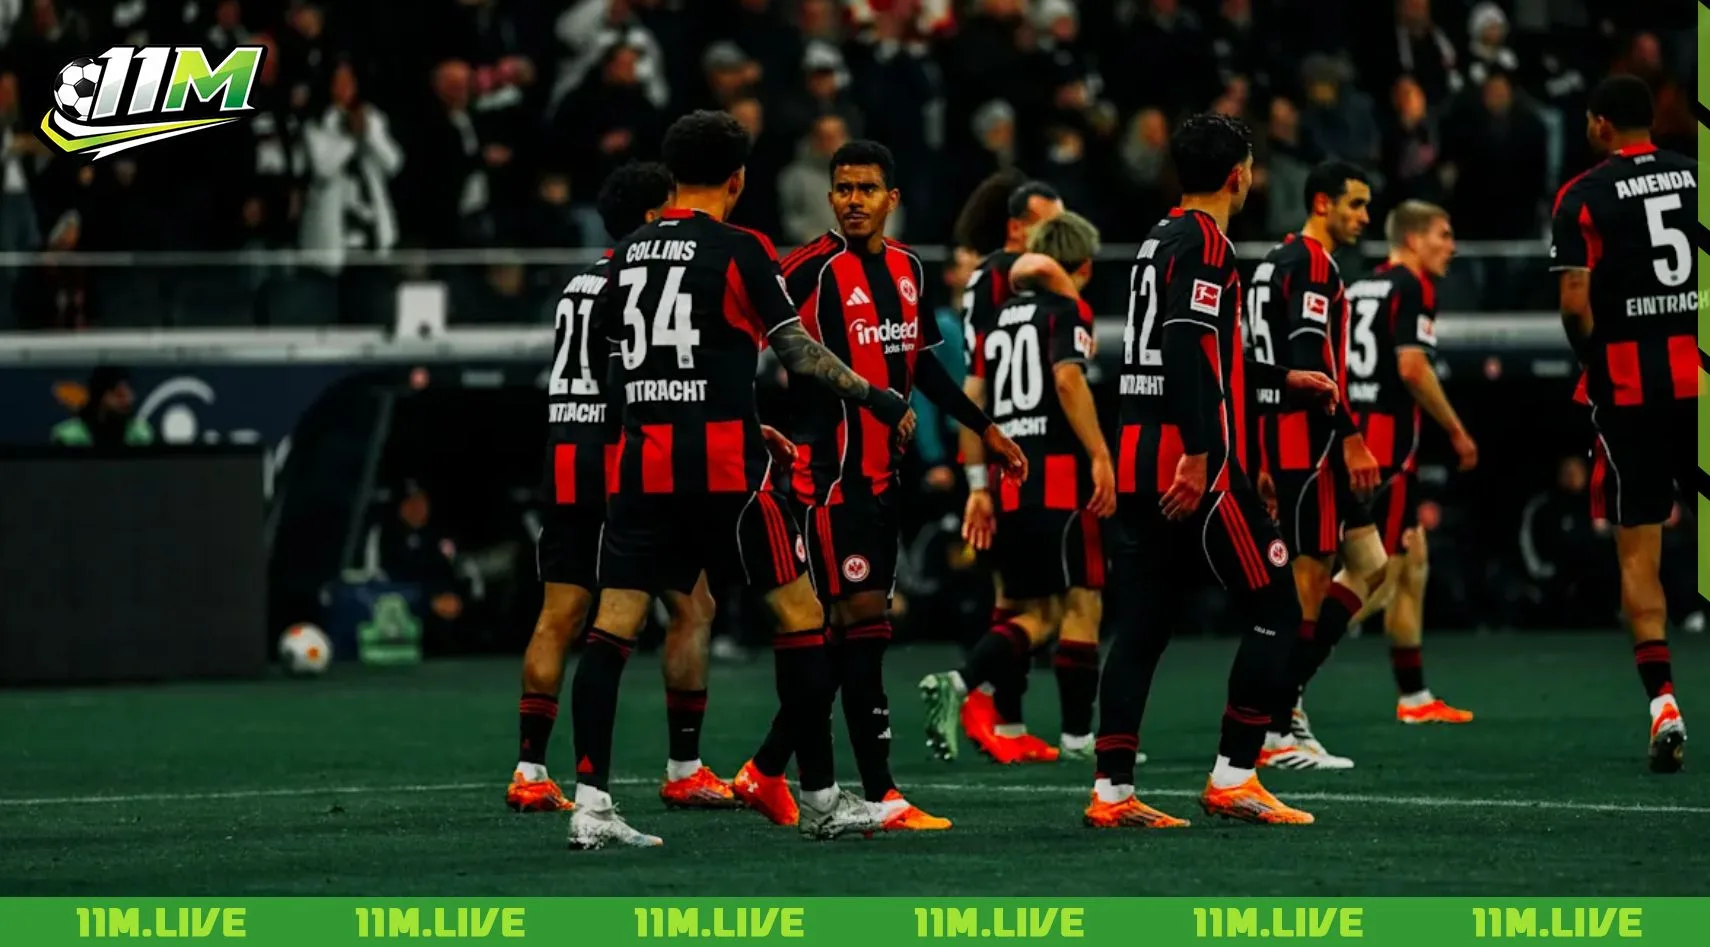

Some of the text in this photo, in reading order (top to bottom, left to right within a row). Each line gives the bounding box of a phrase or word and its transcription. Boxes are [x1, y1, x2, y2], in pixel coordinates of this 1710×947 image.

[1614, 170, 1697, 200] AMENDA
[626, 240, 697, 263] COLLINS
[1643, 193, 1693, 287] 5
[618, 266, 700, 370] 34
[855, 316, 918, 345] indeed
[1346, 298, 1379, 378] 3
[1626, 289, 1710, 317] EINTRACH
[549, 297, 600, 396] 21
[984, 323, 1044, 418] 20
